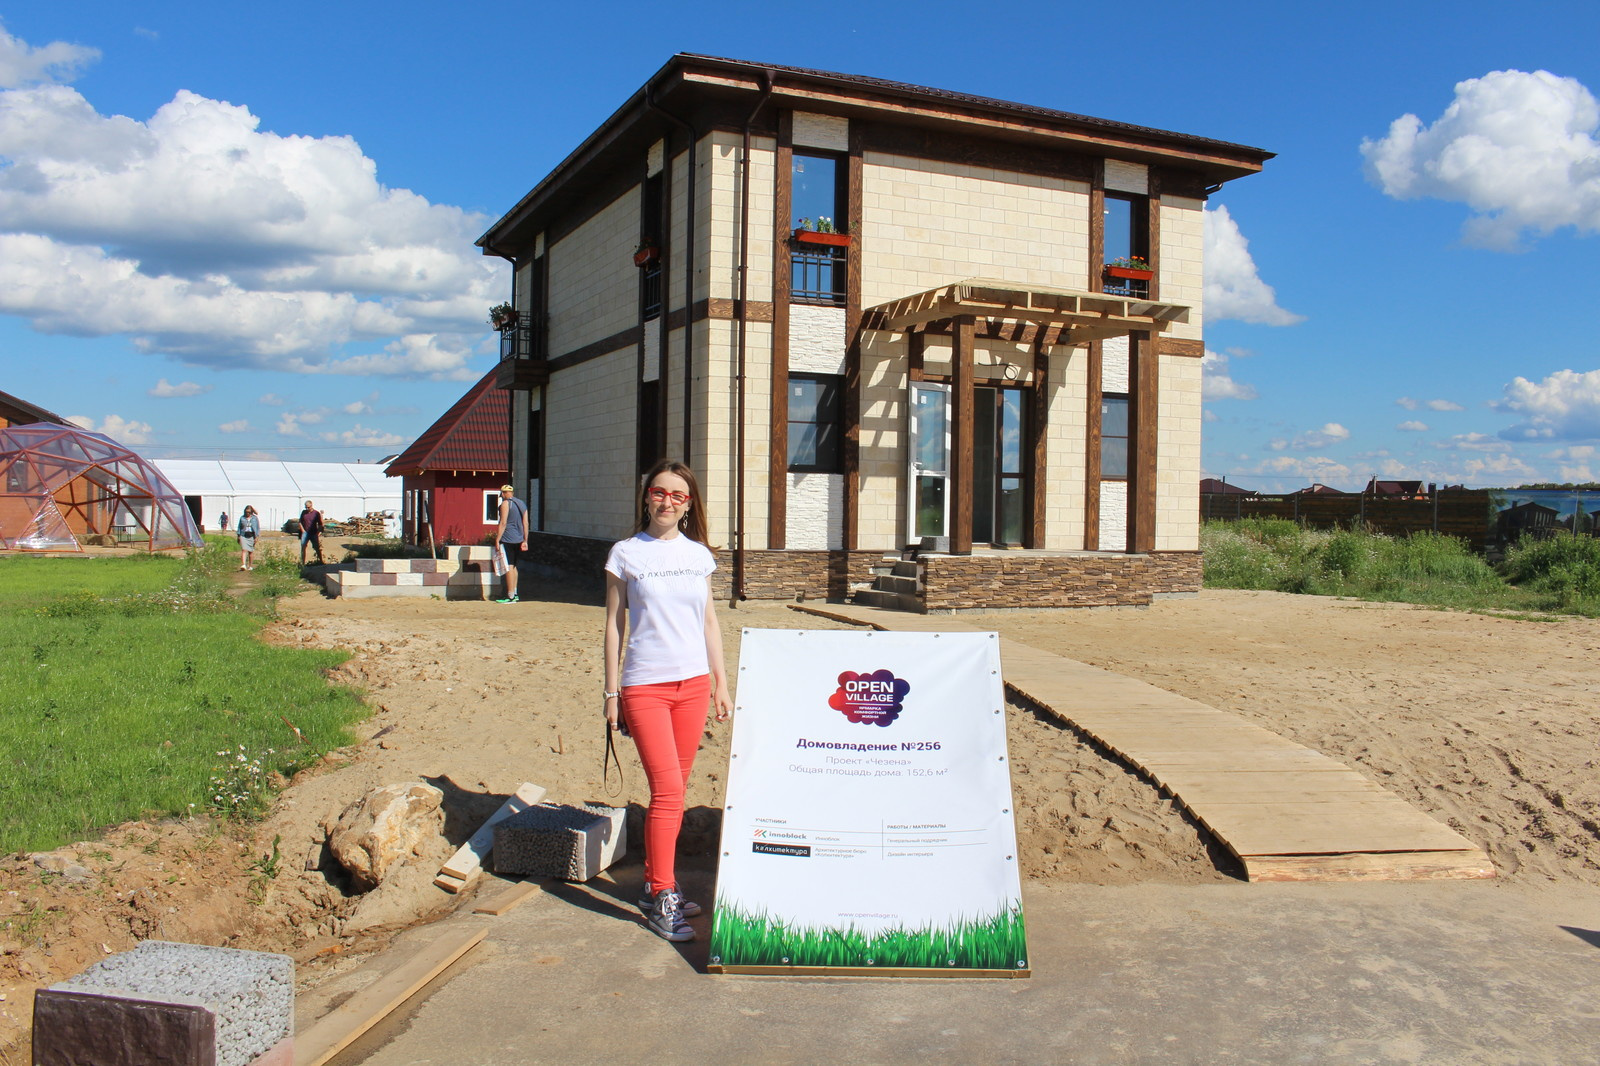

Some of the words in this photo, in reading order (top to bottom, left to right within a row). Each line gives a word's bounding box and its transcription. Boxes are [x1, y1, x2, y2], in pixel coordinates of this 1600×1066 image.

[845, 681, 894, 693] OPEN
[845, 693, 894, 702] VILLAGE
[796, 738, 898, 752] Домовладение
[901, 741, 942, 751] №256
[825, 755, 863, 766] Проект
[865, 758, 912, 766] «Чезена»
[788, 764, 824, 775] Общая
[826, 768, 872, 777] площадь
[906, 768, 934, 778] 152,6
[769, 831, 807, 840] innoblock
